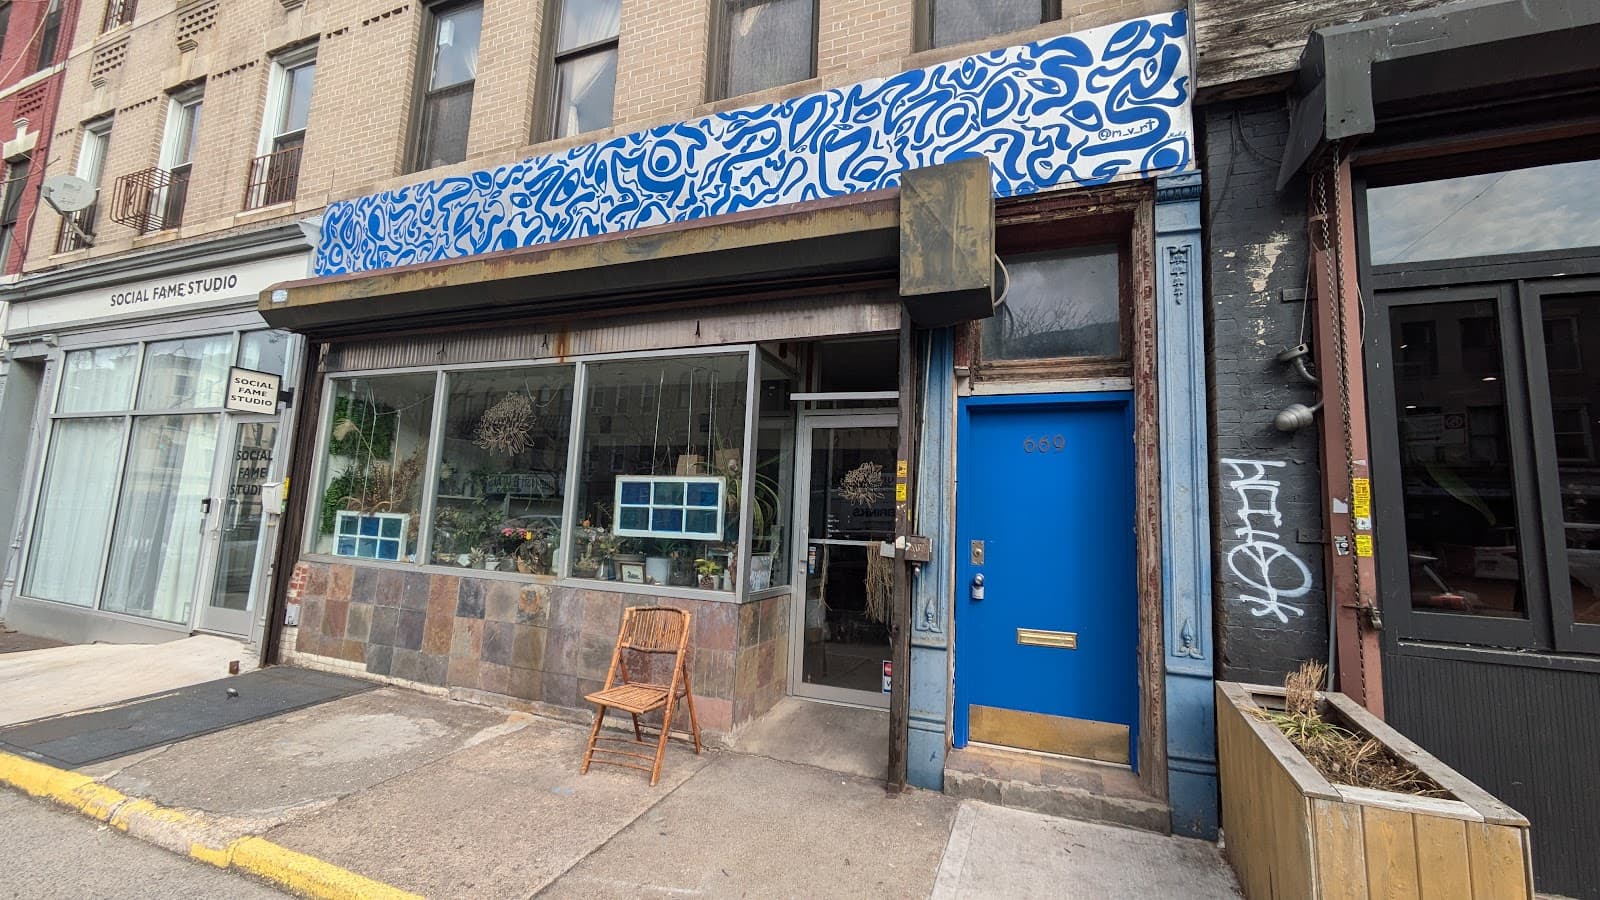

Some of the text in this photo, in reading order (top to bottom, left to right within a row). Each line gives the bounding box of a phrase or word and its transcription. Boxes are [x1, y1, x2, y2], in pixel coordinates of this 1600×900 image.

[110, 274, 237, 307] SOCIAL FAME STUDIO
[234, 377, 273, 390] SOCIAL
[238, 387, 267, 397] FAME
[231, 395, 273, 407] STUDIO
[1023, 434, 1066, 454] 669
[236, 450, 273, 461] SOCIAL
[239, 467, 267, 479] FAME
[230, 484, 262, 497] STUDI
